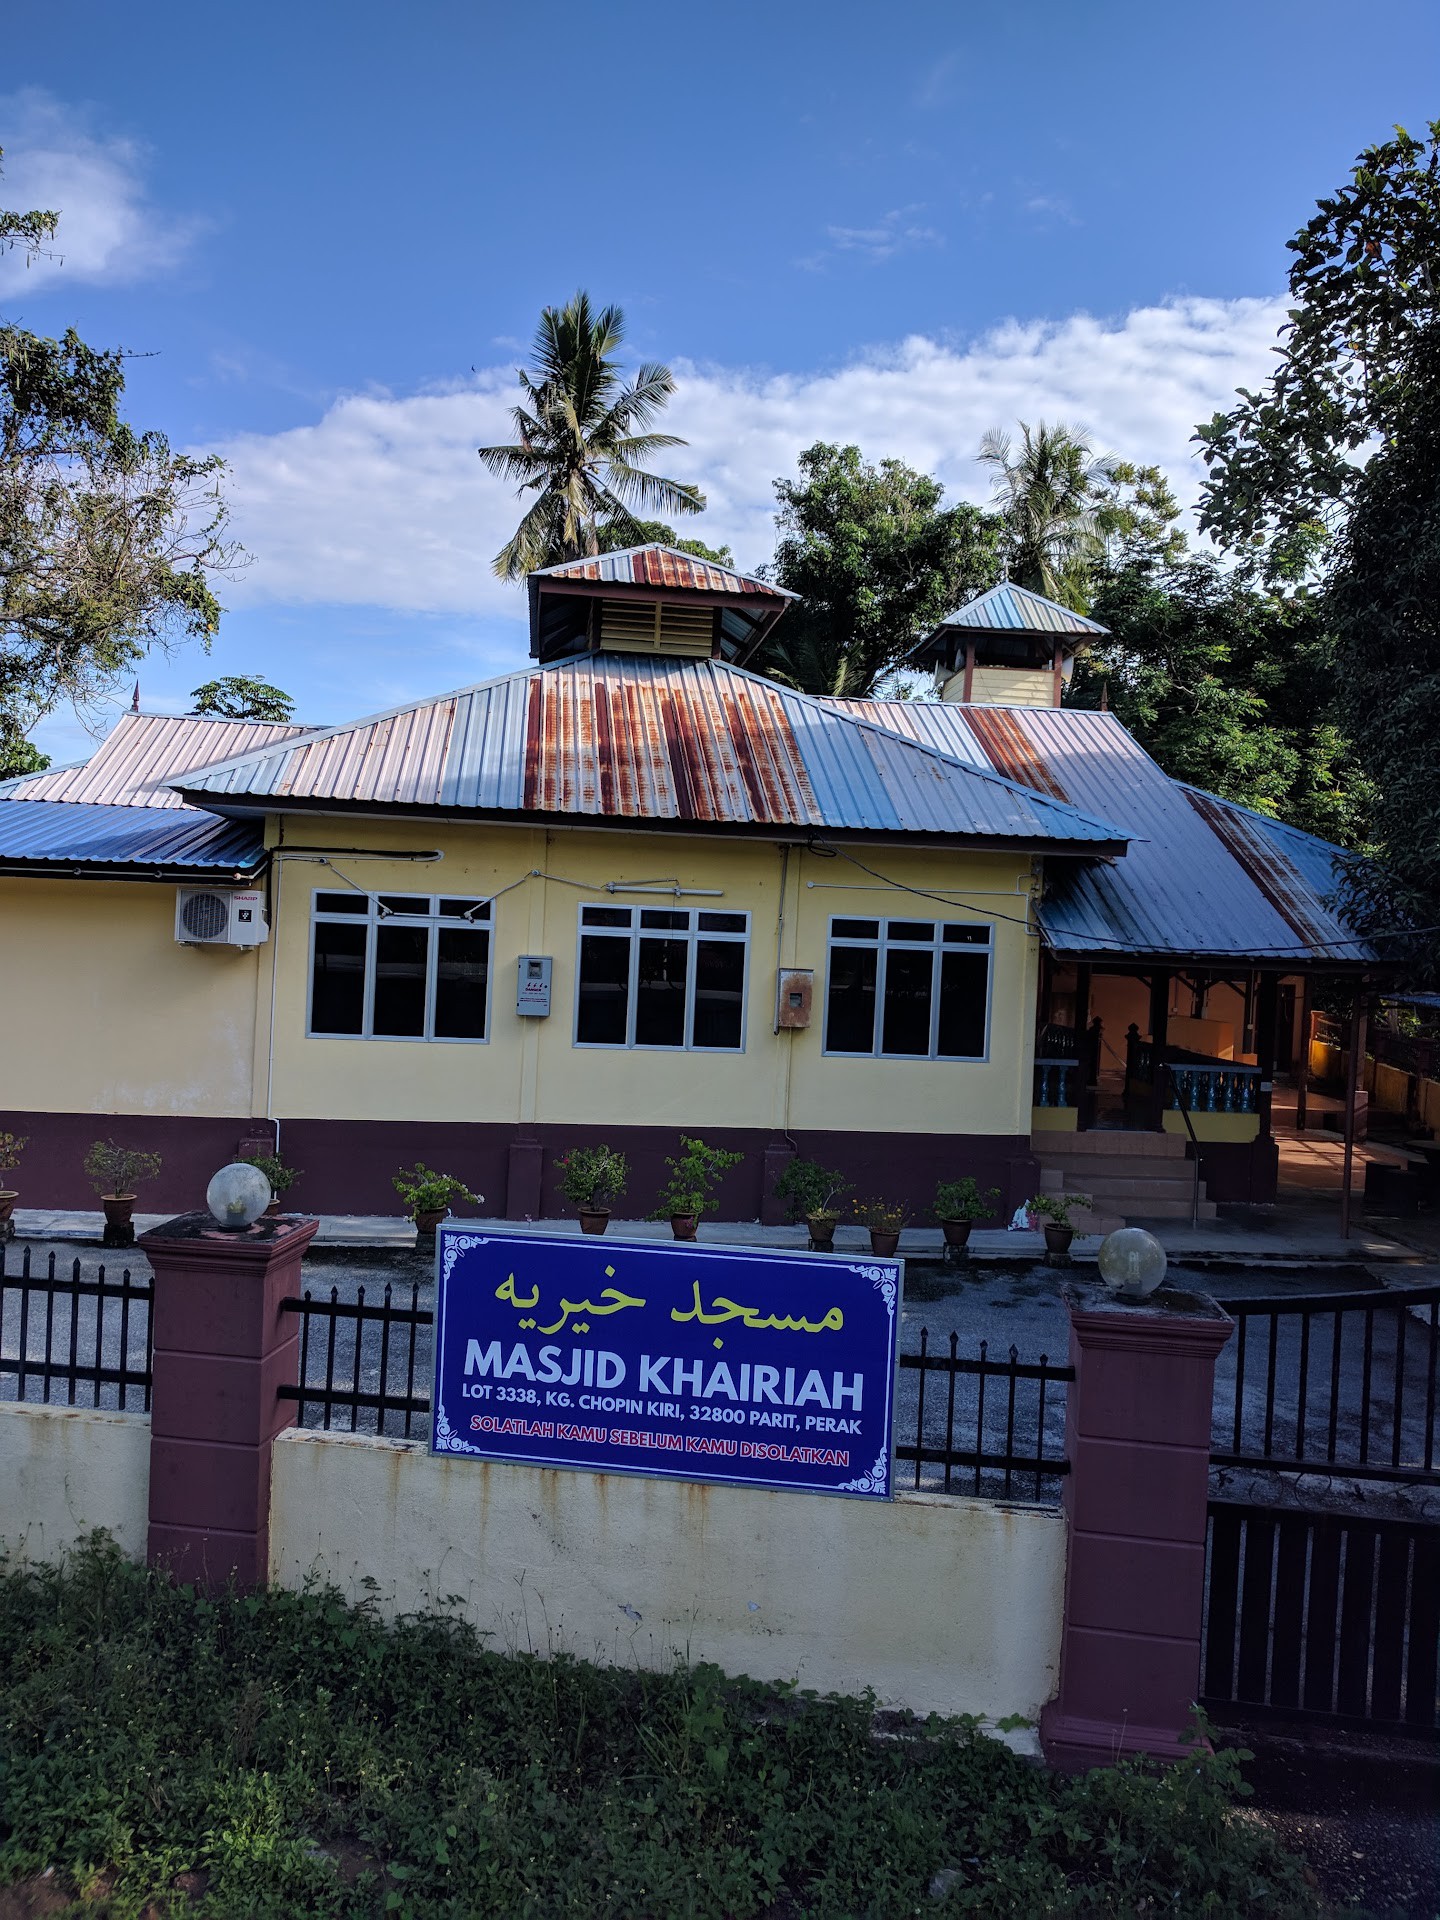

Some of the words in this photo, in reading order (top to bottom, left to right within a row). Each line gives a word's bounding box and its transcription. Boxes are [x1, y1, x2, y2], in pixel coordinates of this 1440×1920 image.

[494, 1265, 647, 1335] خيريه
[670, 1280, 844, 1350] مسجد
[462, 1383, 493, 1400] LOT
[496, 1387, 541, 1407] 3338,
[545, 1391, 575, 1408] KG.
[578, 1395, 643, 1415] CHOPIN
[647, 1401, 685, 1422] KIRI,
[689, 1405, 746, 1425] 32800
[749, 1411, 801, 1432] PARIT,
[805, 1416, 862, 1435] PERAK
[463, 1339, 626, 1388] MASJID
[639, 1355, 864, 1412] KHAIRIAH
[470, 1415, 554, 1438] SOLATLAH
[556, 1423, 607, 1444] KAMU
[609, 1429, 683, 1451] SEBELUM
[685, 1436, 738, 1457] KAMU
[740, 1441, 850, 1467] DISOLATKAN
